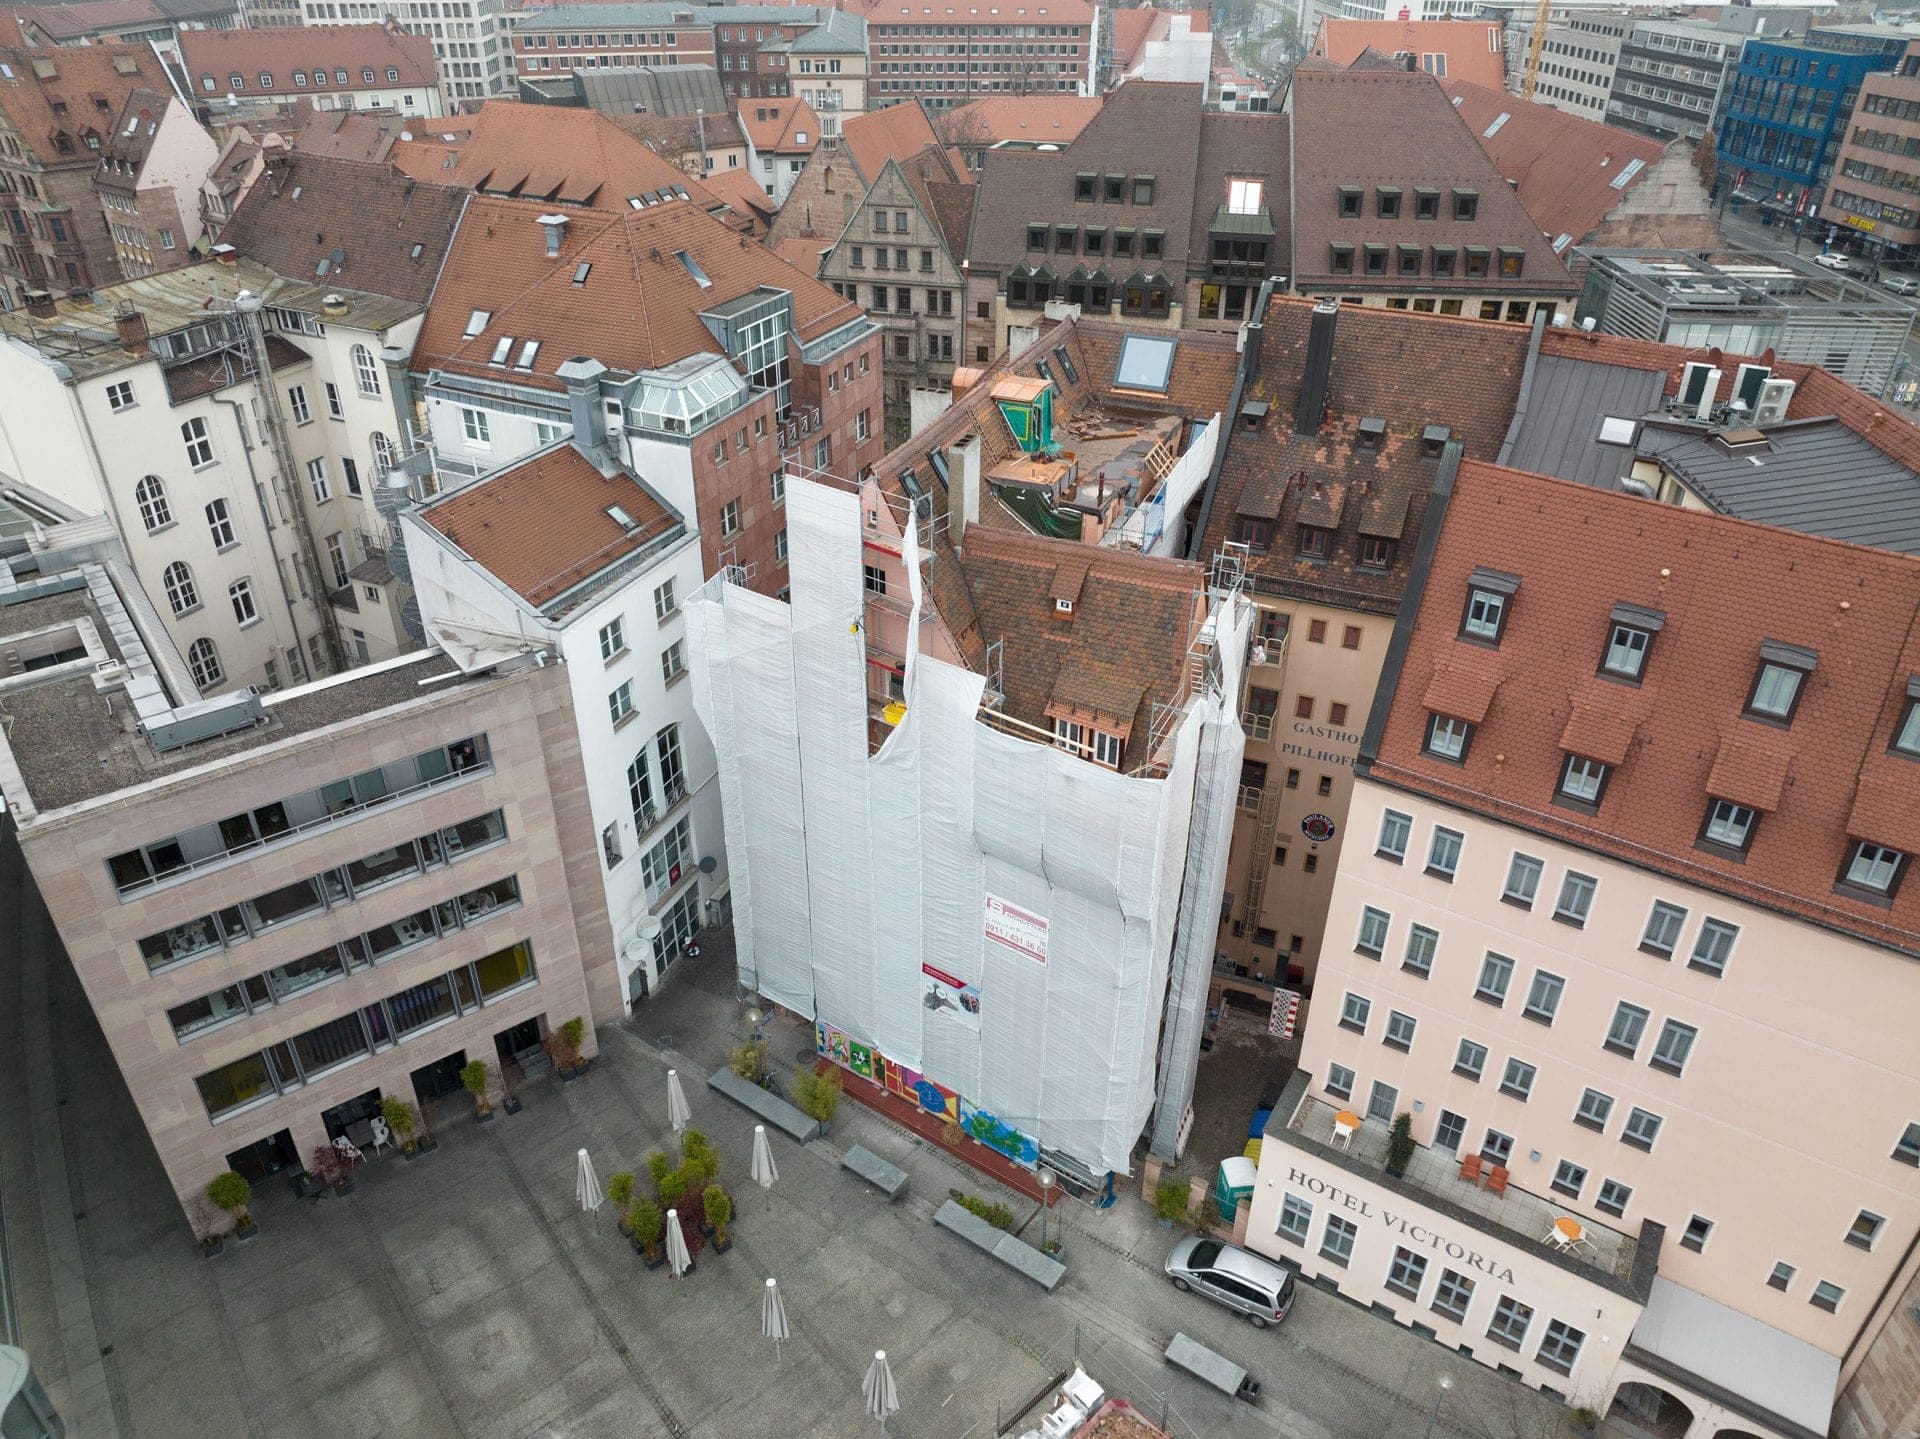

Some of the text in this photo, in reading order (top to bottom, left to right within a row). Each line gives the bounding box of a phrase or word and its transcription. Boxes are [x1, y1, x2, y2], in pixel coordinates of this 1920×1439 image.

[1293, 722, 1362, 745] GASTHO
[985, 922, 1003, 936] 0911
[1010, 934, 1023, 945] 431
[1036, 945, 1046, 955] 60
[1288, 1167, 1516, 1286] HOTEL VICTORIA
